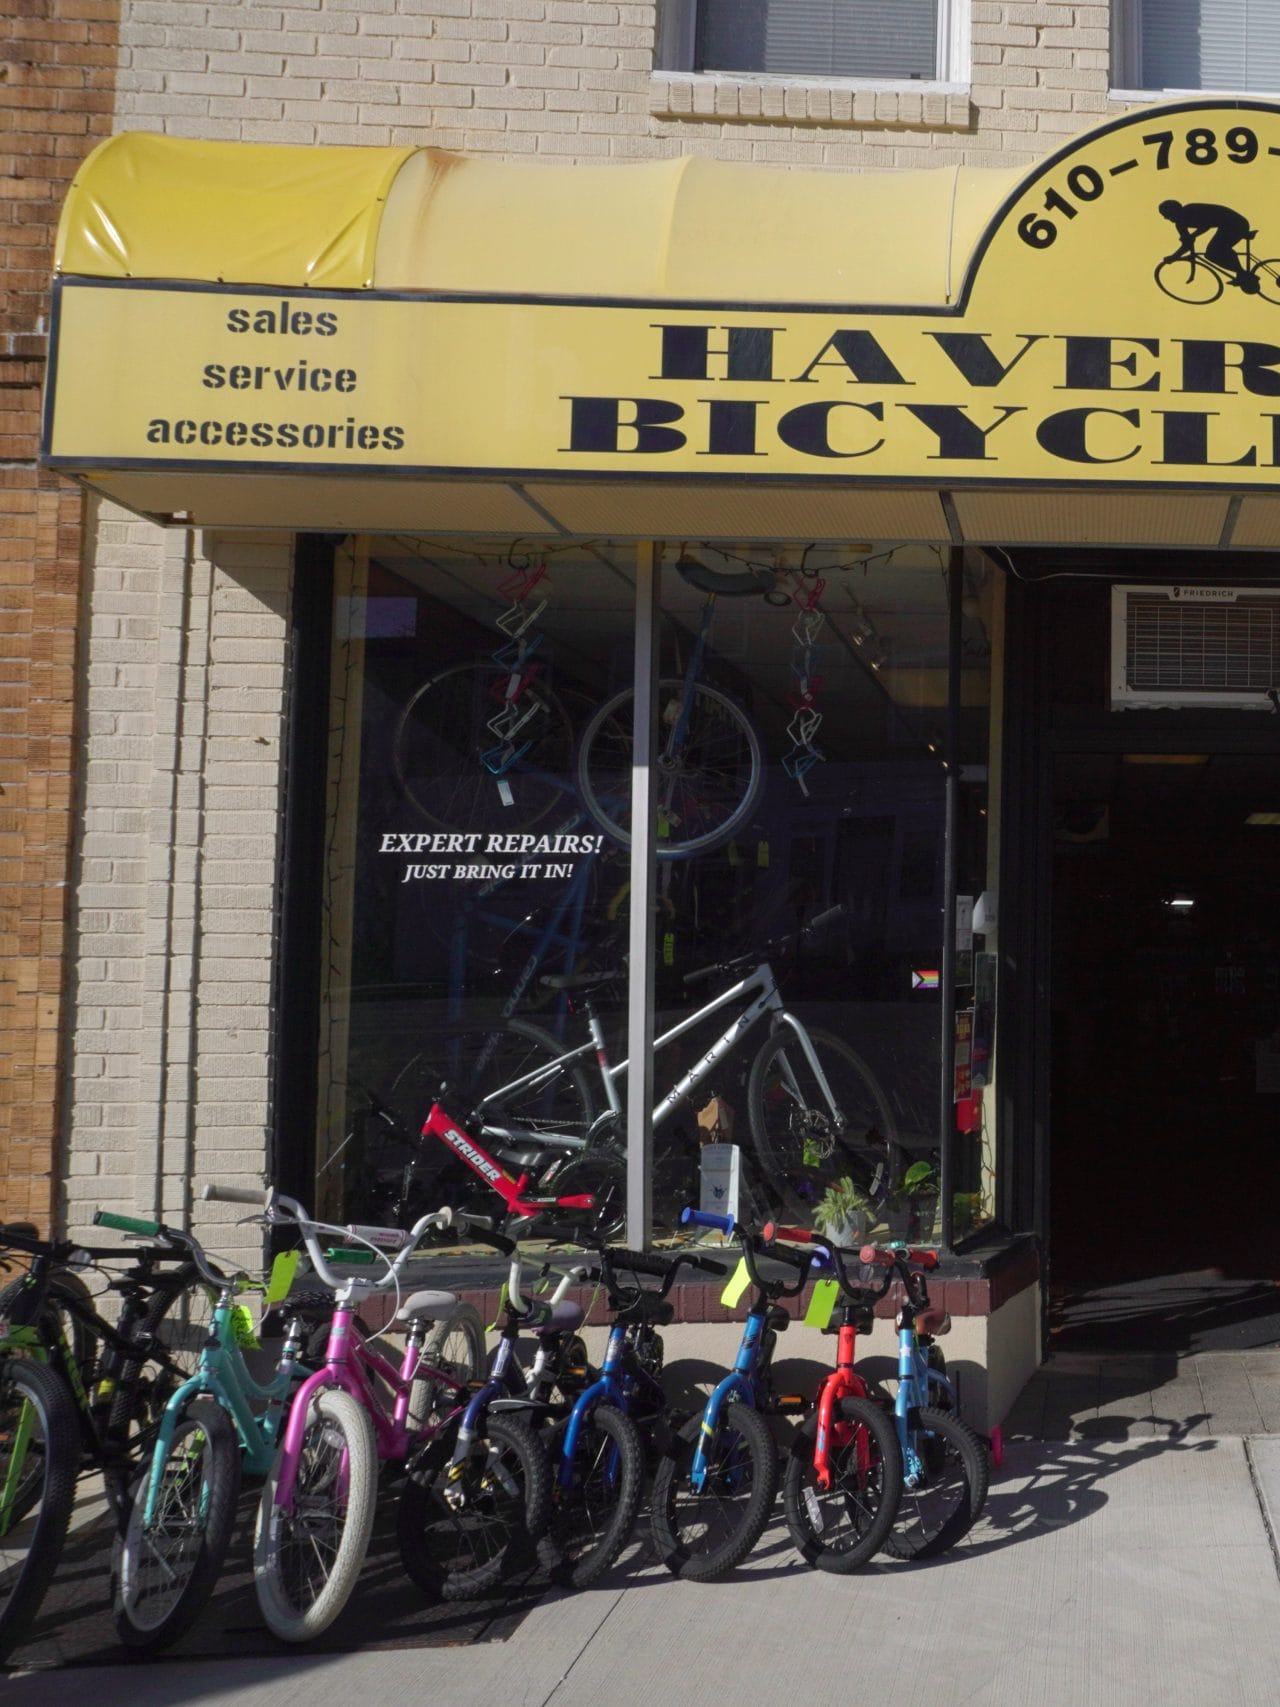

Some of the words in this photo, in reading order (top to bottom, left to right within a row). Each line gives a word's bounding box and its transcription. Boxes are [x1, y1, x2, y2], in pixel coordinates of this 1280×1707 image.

[226, 301, 340, 338] sales
[202, 361, 358, 394] service
[146, 416, 407, 452] accessories
[378, 833, 482, 853] EXPERT
[484, 834, 604, 854] REPAIRS!
[401, 864, 451, 884] JUST
[452, 865, 516, 879] BRING
[520, 864, 541, 878] IT
[544, 864, 574, 878] IN!
[443, 1129, 501, 1182] STRIDER
